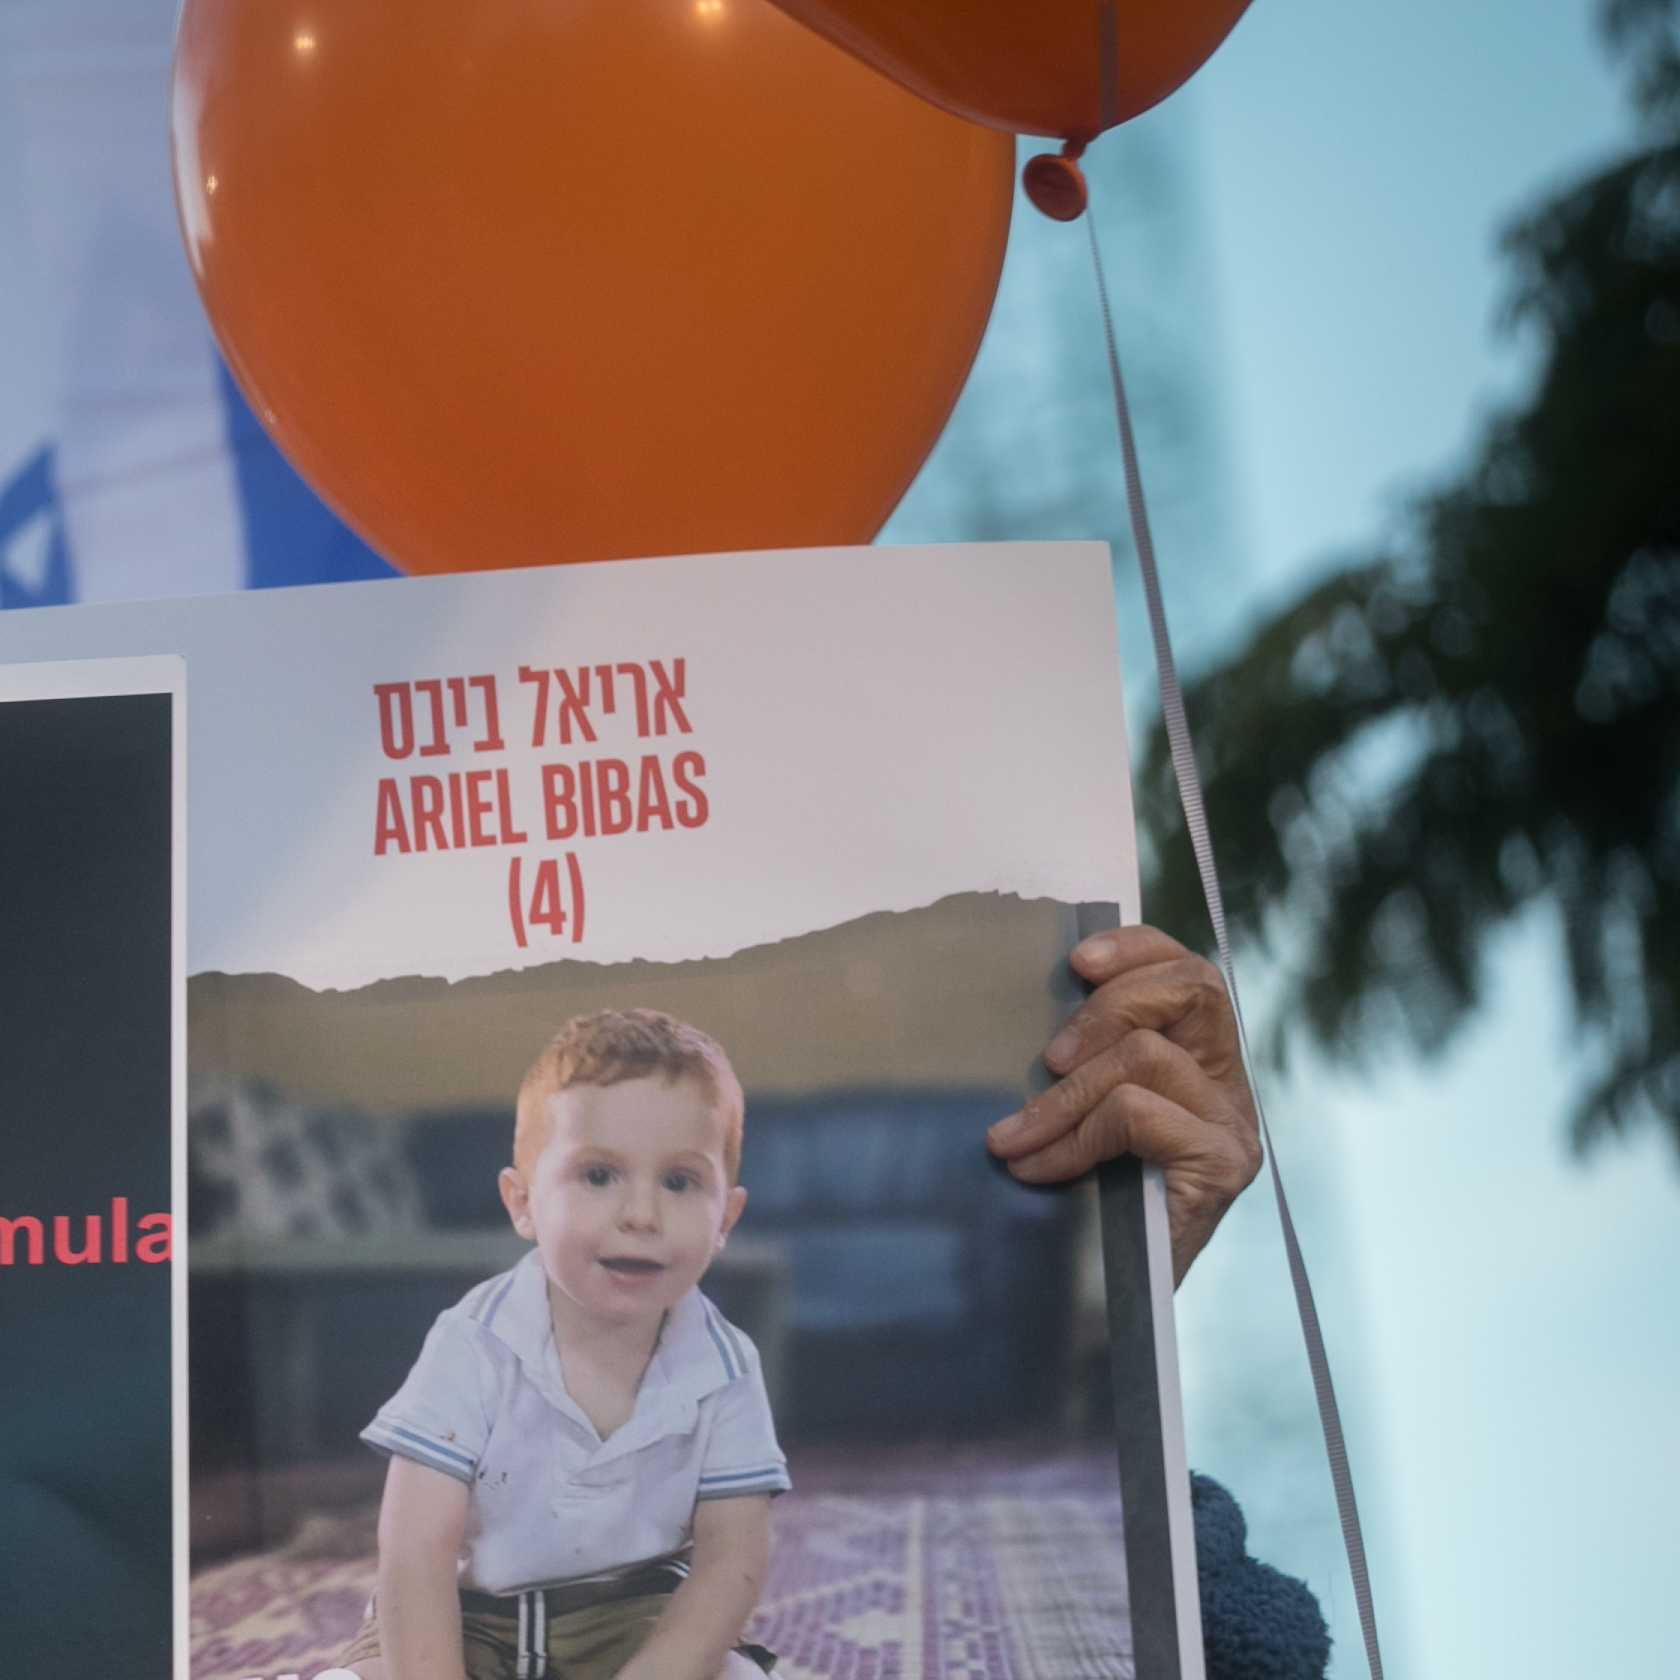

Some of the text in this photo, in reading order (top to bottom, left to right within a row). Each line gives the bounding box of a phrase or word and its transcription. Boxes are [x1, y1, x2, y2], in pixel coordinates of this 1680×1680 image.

[372, 657, 693, 760] אריאל ביבס
[373, 750, 710, 857] ARIEL BIBAS
[508, 851, 586, 949] (4)
